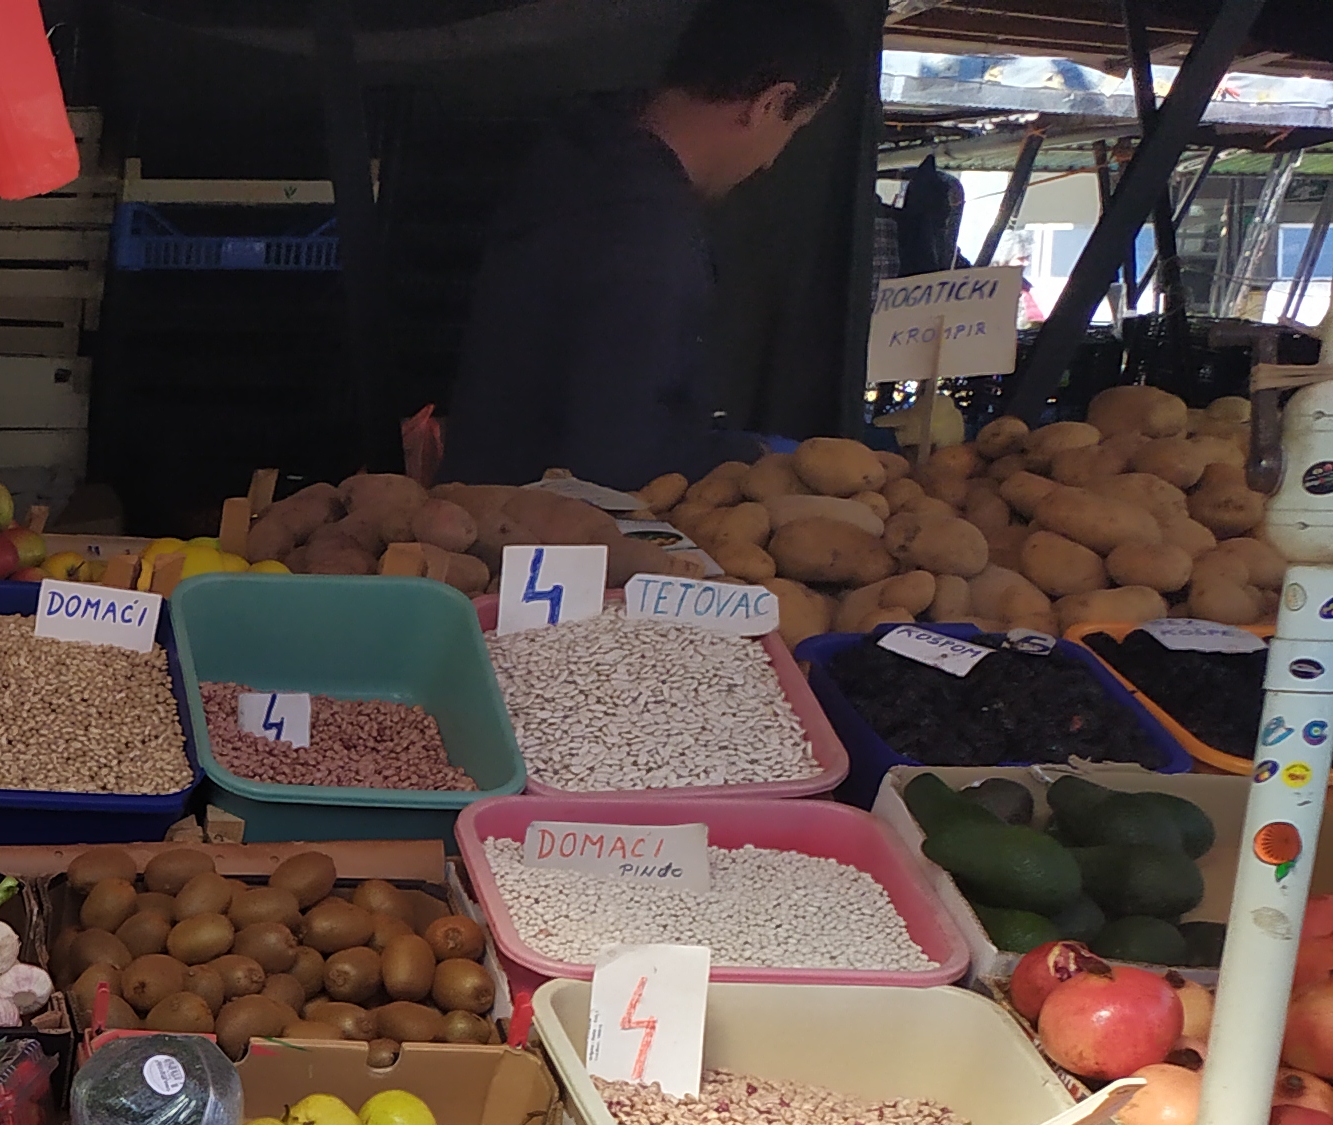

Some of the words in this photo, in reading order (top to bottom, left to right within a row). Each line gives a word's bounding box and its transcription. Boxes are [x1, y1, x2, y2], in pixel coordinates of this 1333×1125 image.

[875, 276, 1000, 315] ROGATIČKI
[522, 550, 564, 624] 4
[635, 577, 771, 618] TETOVAC
[263, 694, 285, 741] 4
